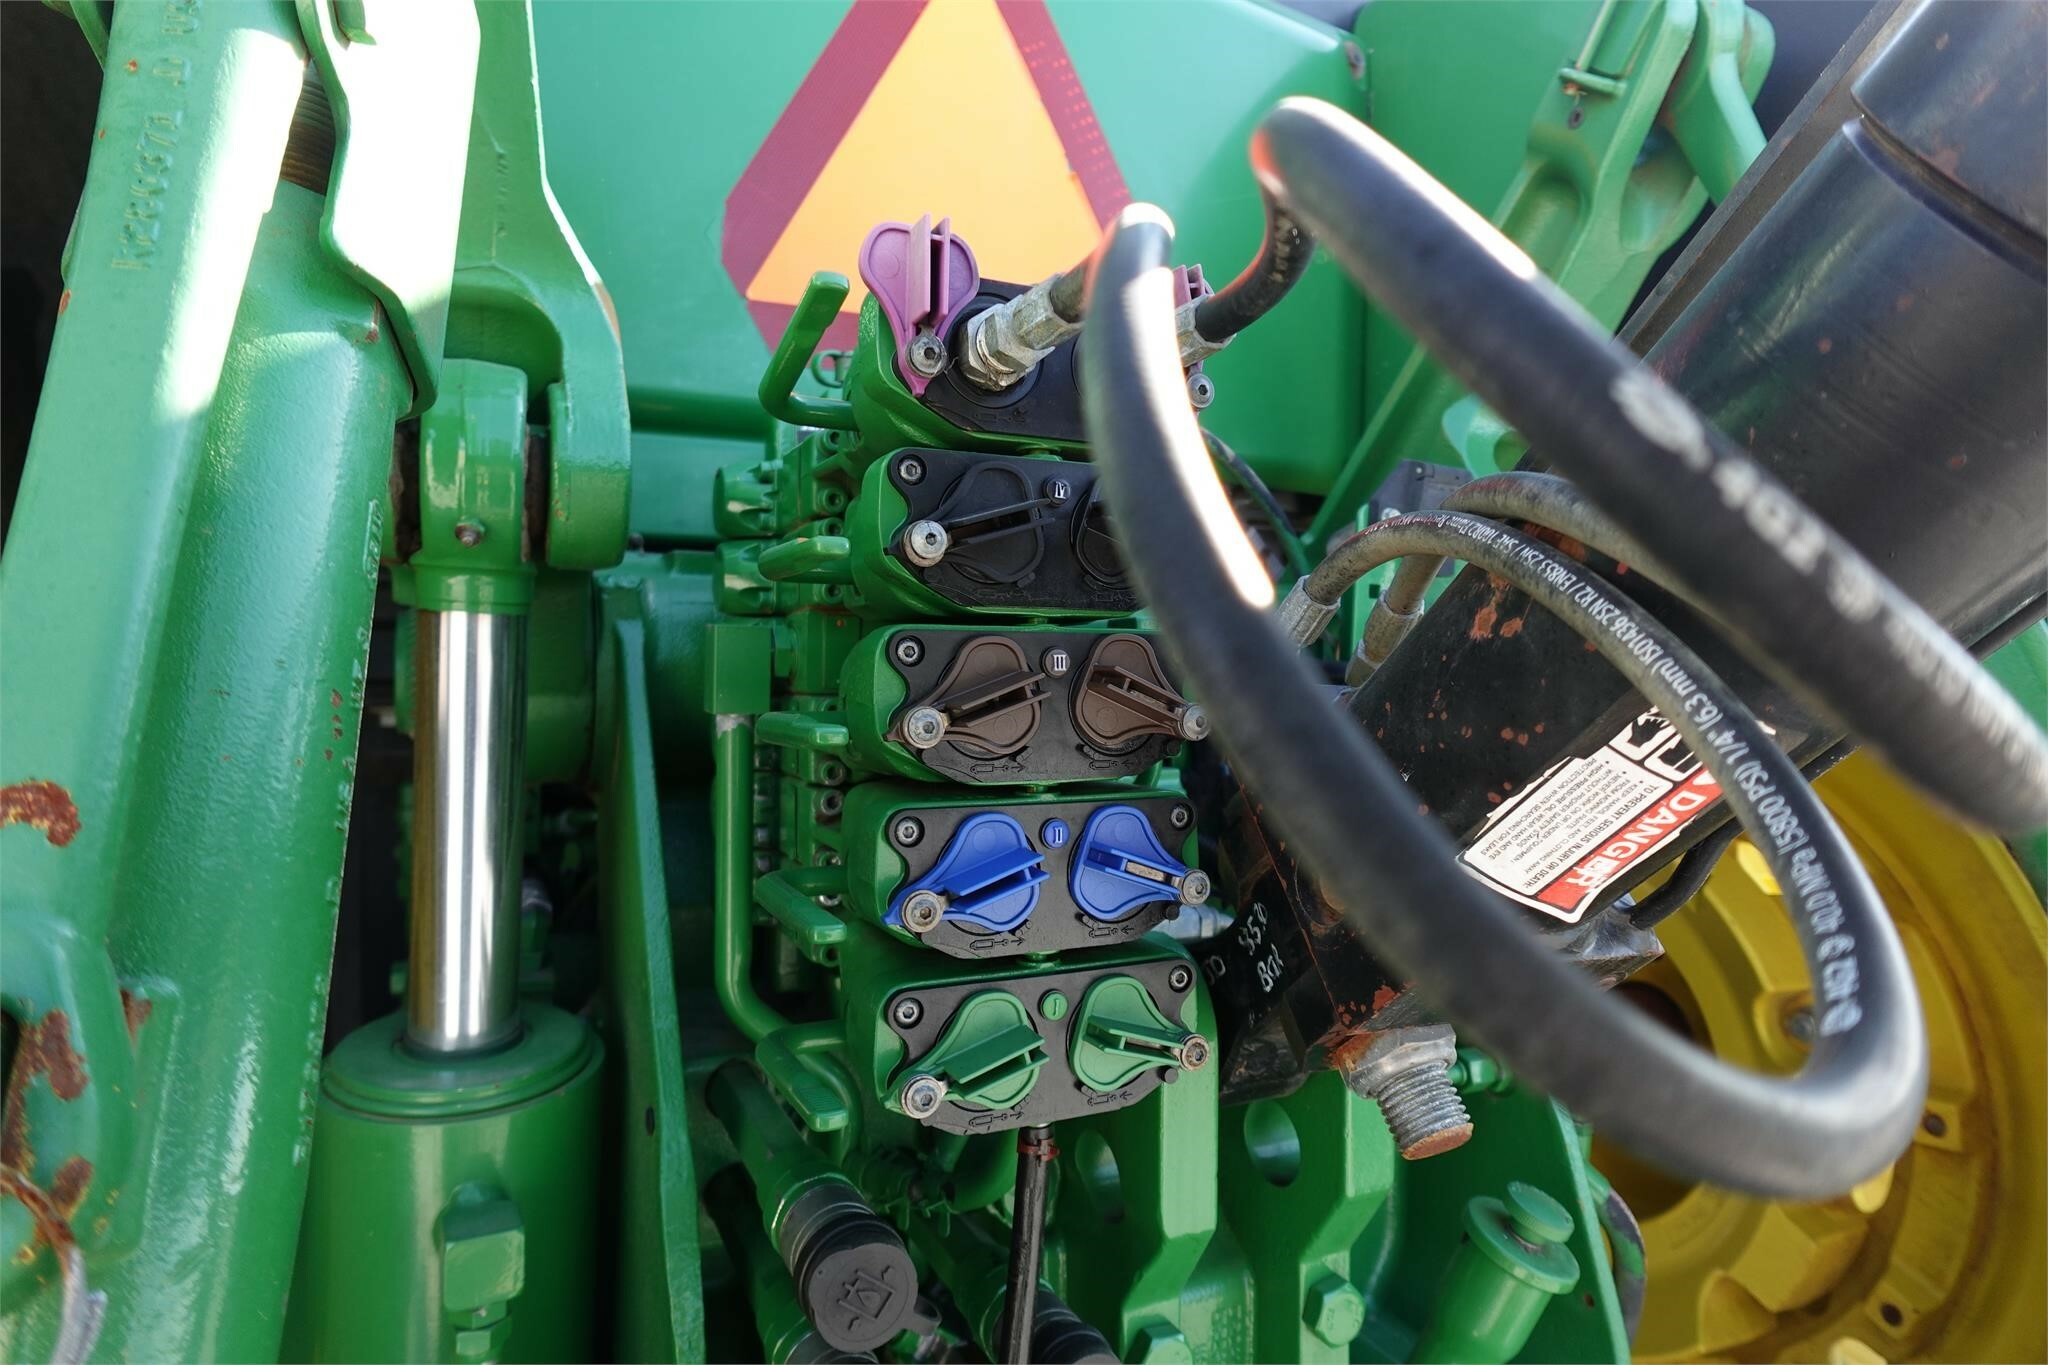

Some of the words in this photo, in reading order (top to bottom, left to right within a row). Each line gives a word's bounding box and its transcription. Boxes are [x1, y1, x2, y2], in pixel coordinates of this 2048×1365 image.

[1446, 516, 1467, 534] Flame
[1467, 522, 1498, 542] 100R2
[1492, 533, 1519, 553] SAE
[1513, 546, 1544, 570] 2SN
[1535, 558, 1576, 593] EN853
[1573, 585, 1598, 609] R2
[1587, 597, 1620, 626] 2SN
[1608, 615, 1664, 666] ISO1436
[1053, 654, 1068, 671] III
[1650, 656, 1697, 697] mm)
[1684, 692, 1723, 731] (6.3
[1705, 729, 1749, 764] 1/4"
[1556, 757, 1597, 790] PROTECTION
[1583, 768, 1614, 793] WITHOUT
[1586, 763, 1605, 778] HIGH
[1554, 777, 1589, 805] PRESSURE
[1598, 773, 1622, 792] NEVER
[1609, 778, 1631, 794] FROM
[1618, 783, 1638, 797] KEEP
[1642, 782, 1659, 794] TO
[1733, 761, 1775, 801] PSI)
[1539, 789, 1559, 805] WHEN
[1558, 791, 1586, 812] PROPER
[1579, 790, 1601, 807] WORK
[1584, 793, 1612, 814] MOVING
[1609, 792, 1647, 820] PREVENT
[1507, 803, 1542, 831] SEARCHING
[1559, 813, 1572, 823] OR
[1568, 805, 1582, 815] ON
[1525, 813, 1545, 828] WEAR
[1537, 811, 1561, 830] SAFETY
[1539, 821, 1563, 839] UNDER
[1579, 817, 1614, 844] SERIOUS
[1756, 795, 1809, 855] (5800
[1496, 830, 1510, 841] FOR
[1509, 826, 1529, 841] HAND
[1515, 828, 1540, 848] STANDS
[1565, 788, 1707, 890] DANGER
[1566, 828, 1582, 839] AND
[1488, 849, 1501, 859] EYE
[1498, 840, 1513, 851] AND
[1538, 837, 1569, 861] CLOTHING
[1555, 841, 1584, 863] INJURY
[1522, 860, 1541, 874] AWAY
[1545, 860, 1559, 871] OR
[1788, 845, 1830, 898] MPa
